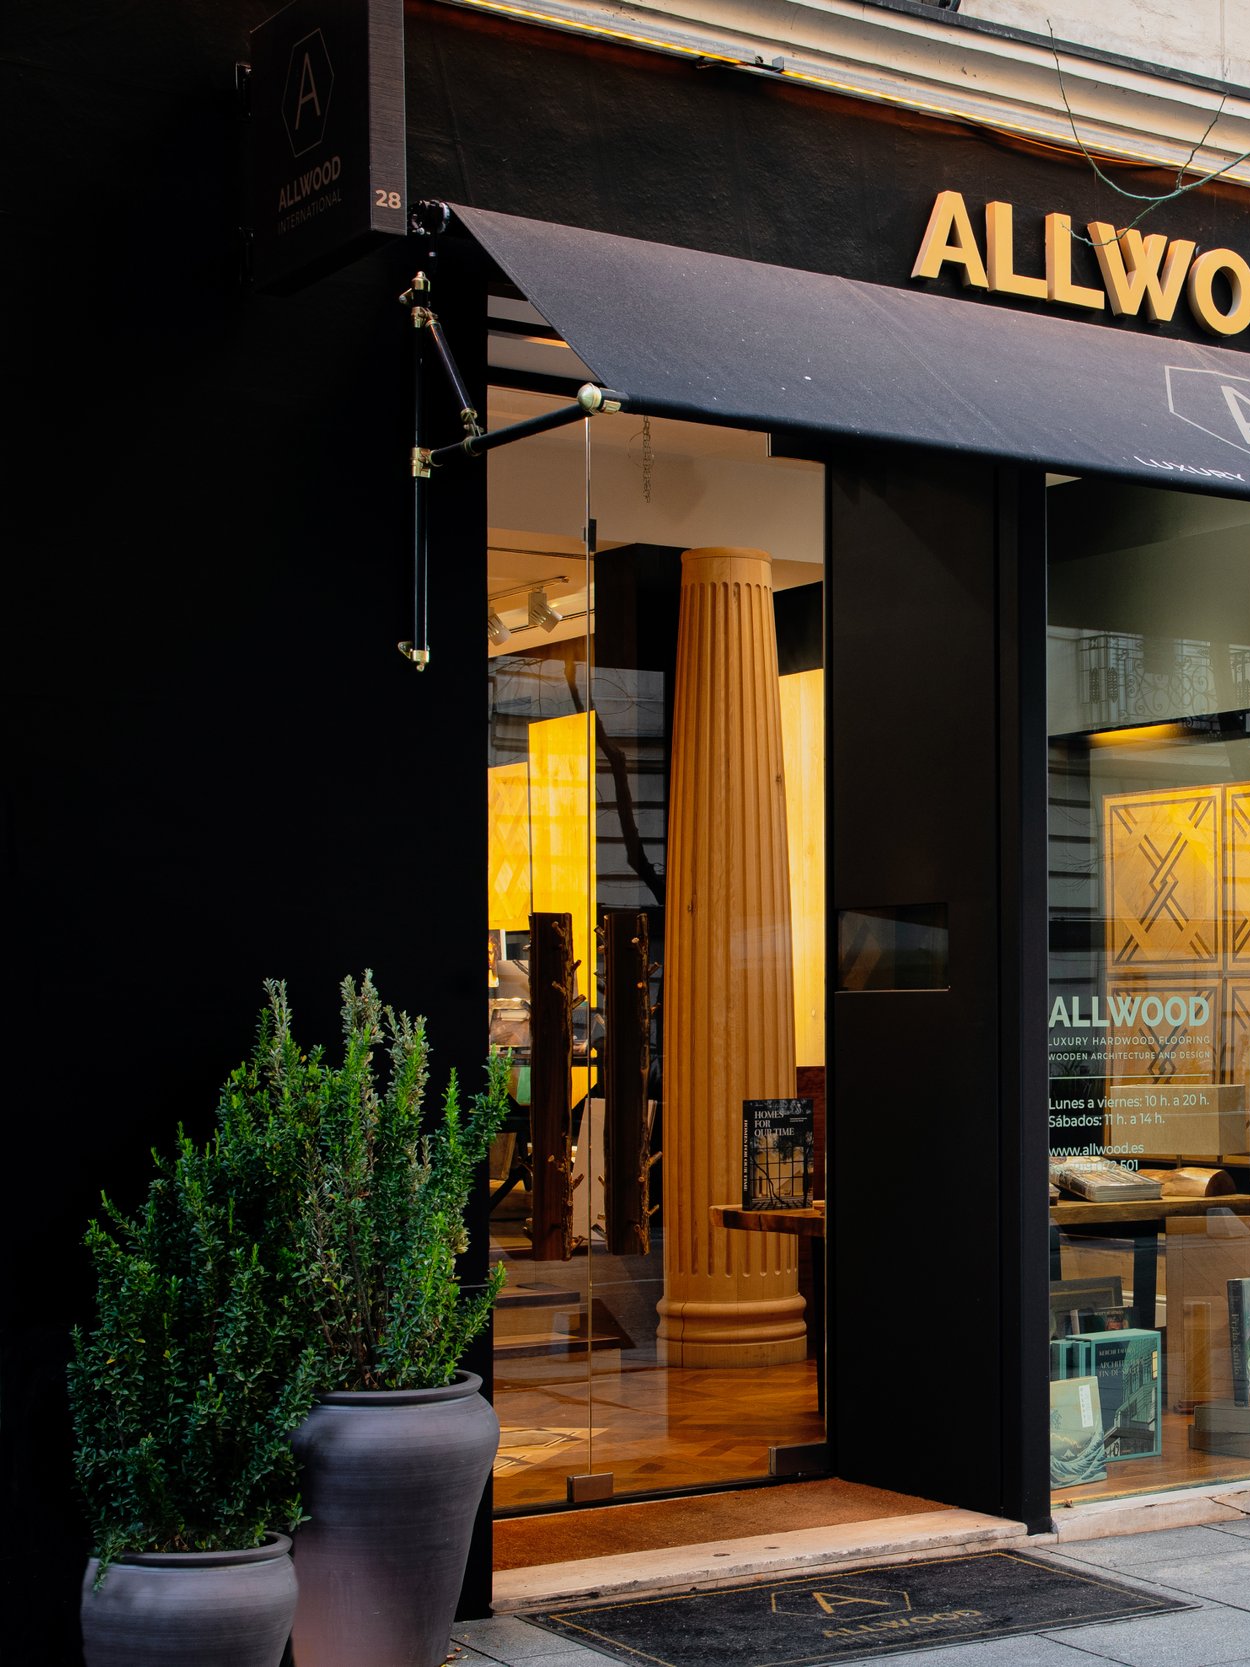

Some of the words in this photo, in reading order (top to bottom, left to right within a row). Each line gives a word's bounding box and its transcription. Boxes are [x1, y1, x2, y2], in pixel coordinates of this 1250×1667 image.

[295, 52, 321, 130] A
[278, 156, 342, 213] ALLWOOD
[375, 190, 401, 209] 28
[278, 188, 342, 236] INTERNATIONAL
[1134, 456, 1245, 482] LUXURY
[1048, 996, 1210, 1028] ALLWOOD
[1092, 1036, 1155, 1046] HARDWOOD
[1158, 1035, 1210, 1045] FLOORING
[1048, 1052, 1088, 1061] WOODEN
[1090, 1051, 1156, 1061] ARCHITECTURE
[1158, 1051, 1178, 1060] AND
[1179, 1051, 1210, 1059] DESIGN
[1048, 1098, 1085, 1110] Lunes
[1087, 1100, 1095, 1109] a
[1097, 1096, 1142, 1109] viernes:
[1144, 1095, 1157, 1107] 10
[1160, 1095, 1170, 1107] h.
[1173, 1097, 1180, 1106] a
[1182, 1094, 1197, 1106] 20
[1199, 1093, 1210, 1105] h.
[754, 1110, 785, 1119] HOMES
[1048, 1114, 1102, 1128] Sábados:
[1104, 1114, 1113, 1125] 11
[1116, 1113, 1127, 1125] h.
[1130, 1116, 1137, 1125] a
[1139, 1113, 1152, 1124] 14
[1154, 1112, 1165, 1124] h.
[754, 1119, 771, 1128] FOR
[754, 1128, 772, 1137] OUR
[773, 1127, 795, 1136] TIME
[1048, 1142, 1145, 1157] www.allwood.es
[1120, 1159, 1139, 1171] 501
[811, 1592, 891, 1614] A
[822, 1609, 982, 1639] ALLWOOD
